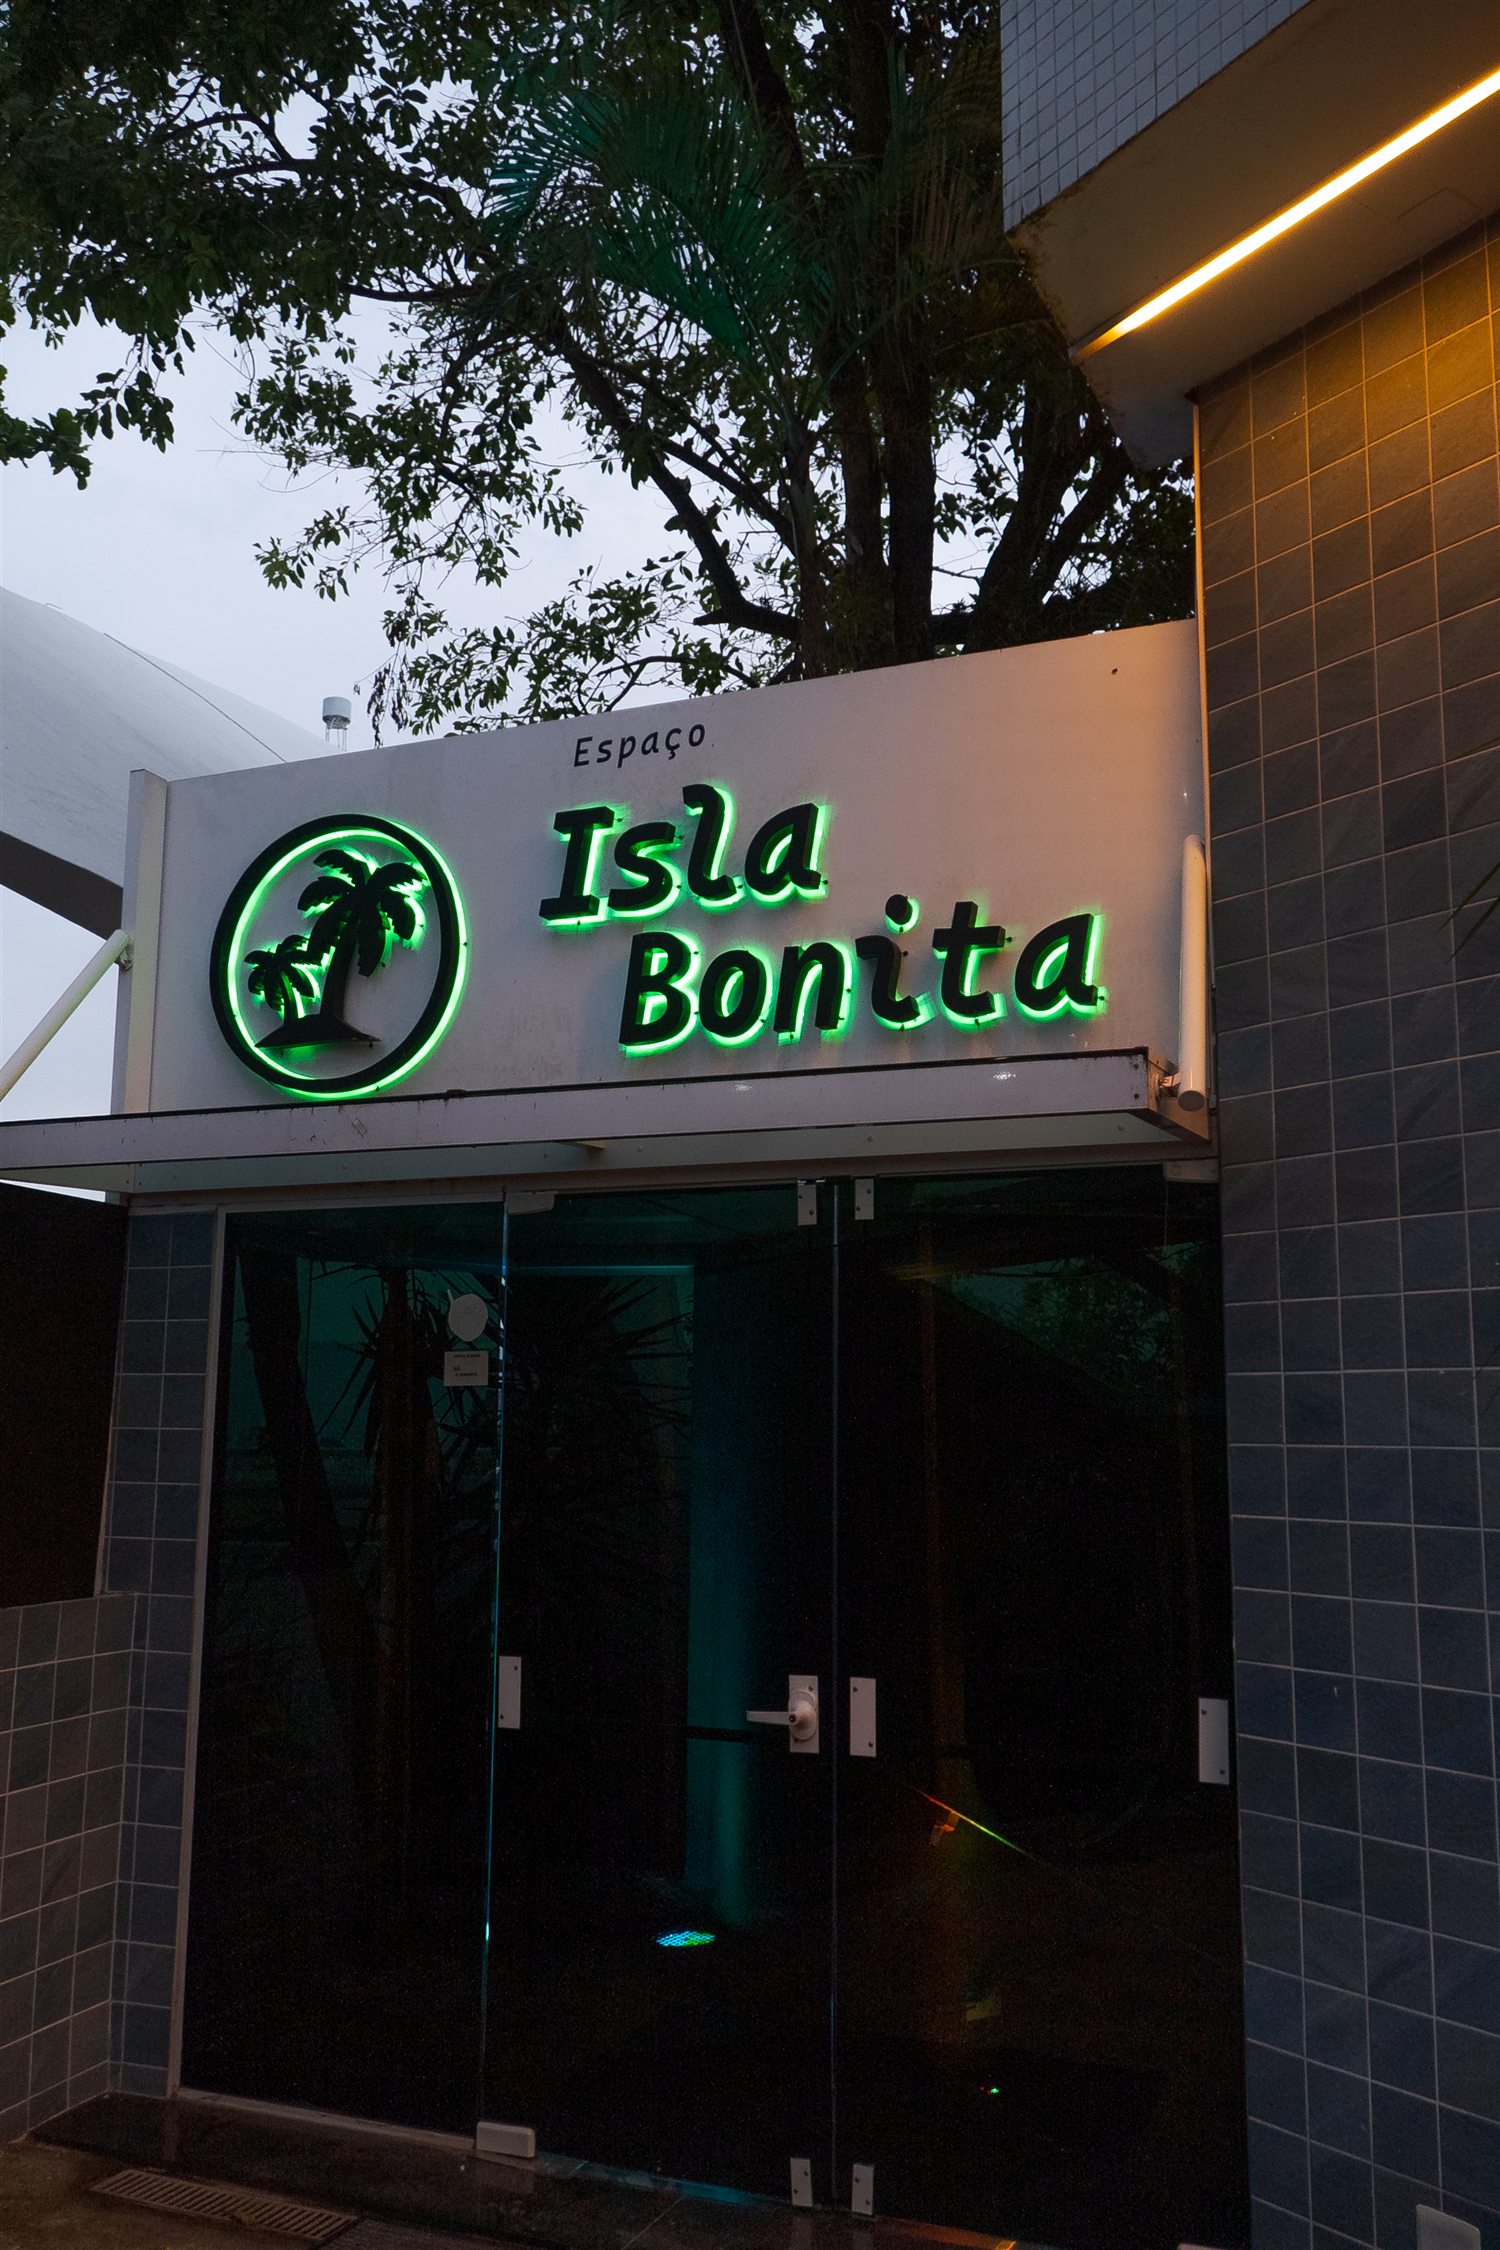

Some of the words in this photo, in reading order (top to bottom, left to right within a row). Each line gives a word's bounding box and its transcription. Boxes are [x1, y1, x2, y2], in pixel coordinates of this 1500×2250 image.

[574, 722, 706, 768] Espaço
[539, 783, 823, 922] Isla
[619, 893, 1100, 1048] Bonita
